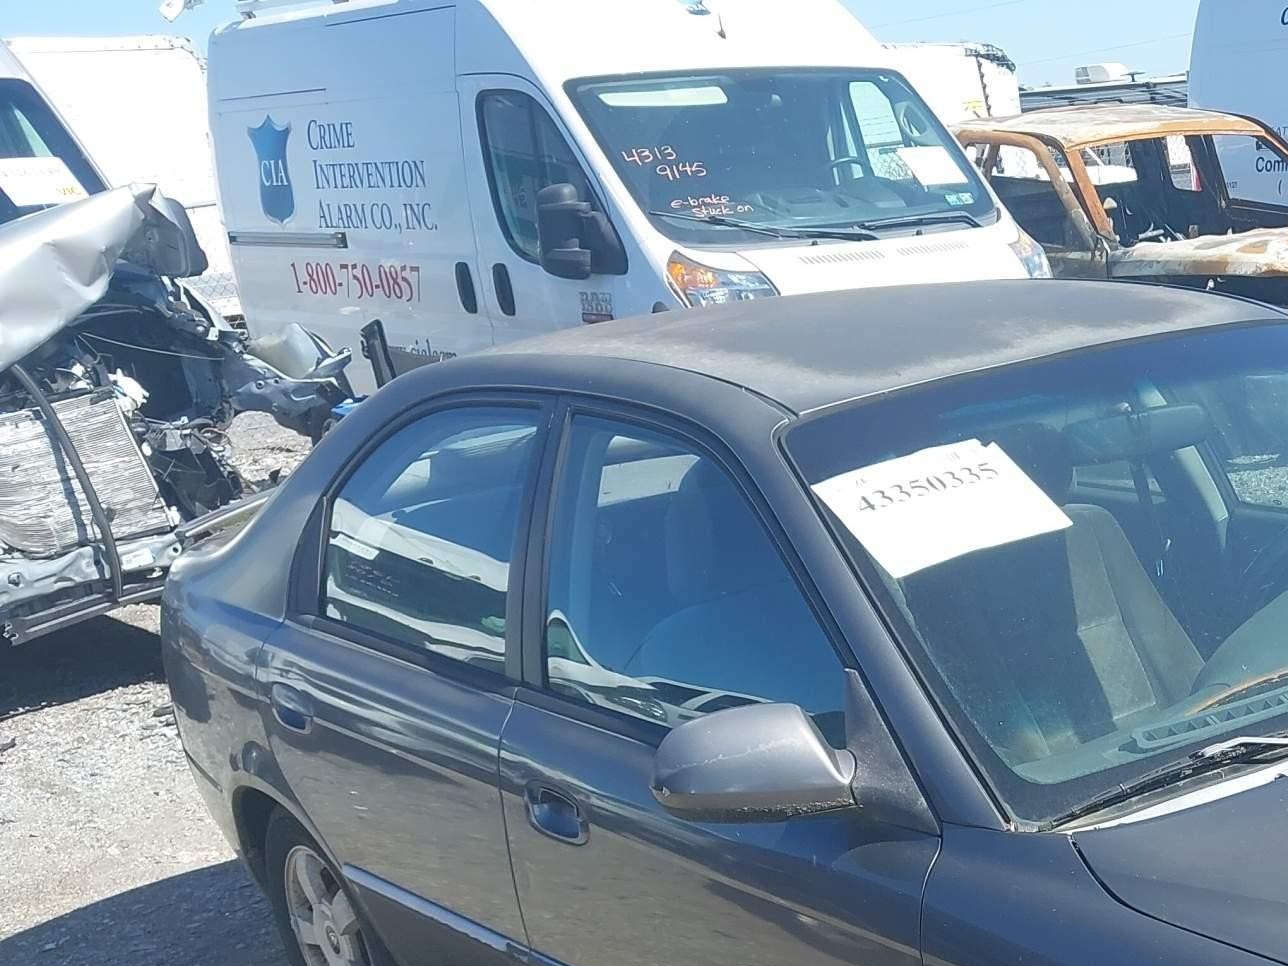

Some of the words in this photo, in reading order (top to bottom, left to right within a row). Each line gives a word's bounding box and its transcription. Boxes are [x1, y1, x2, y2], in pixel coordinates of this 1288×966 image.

[621, 145, 677, 166] 4313
[260, 159, 289, 187] CIA
[656, 162, 708, 181] 9145
[403, 203, 438, 231] INC.
[736, 204, 755, 213] on
[290, 261, 420, 303] 1-800-750-0857
[859, 463, 998, 512] 43350335
